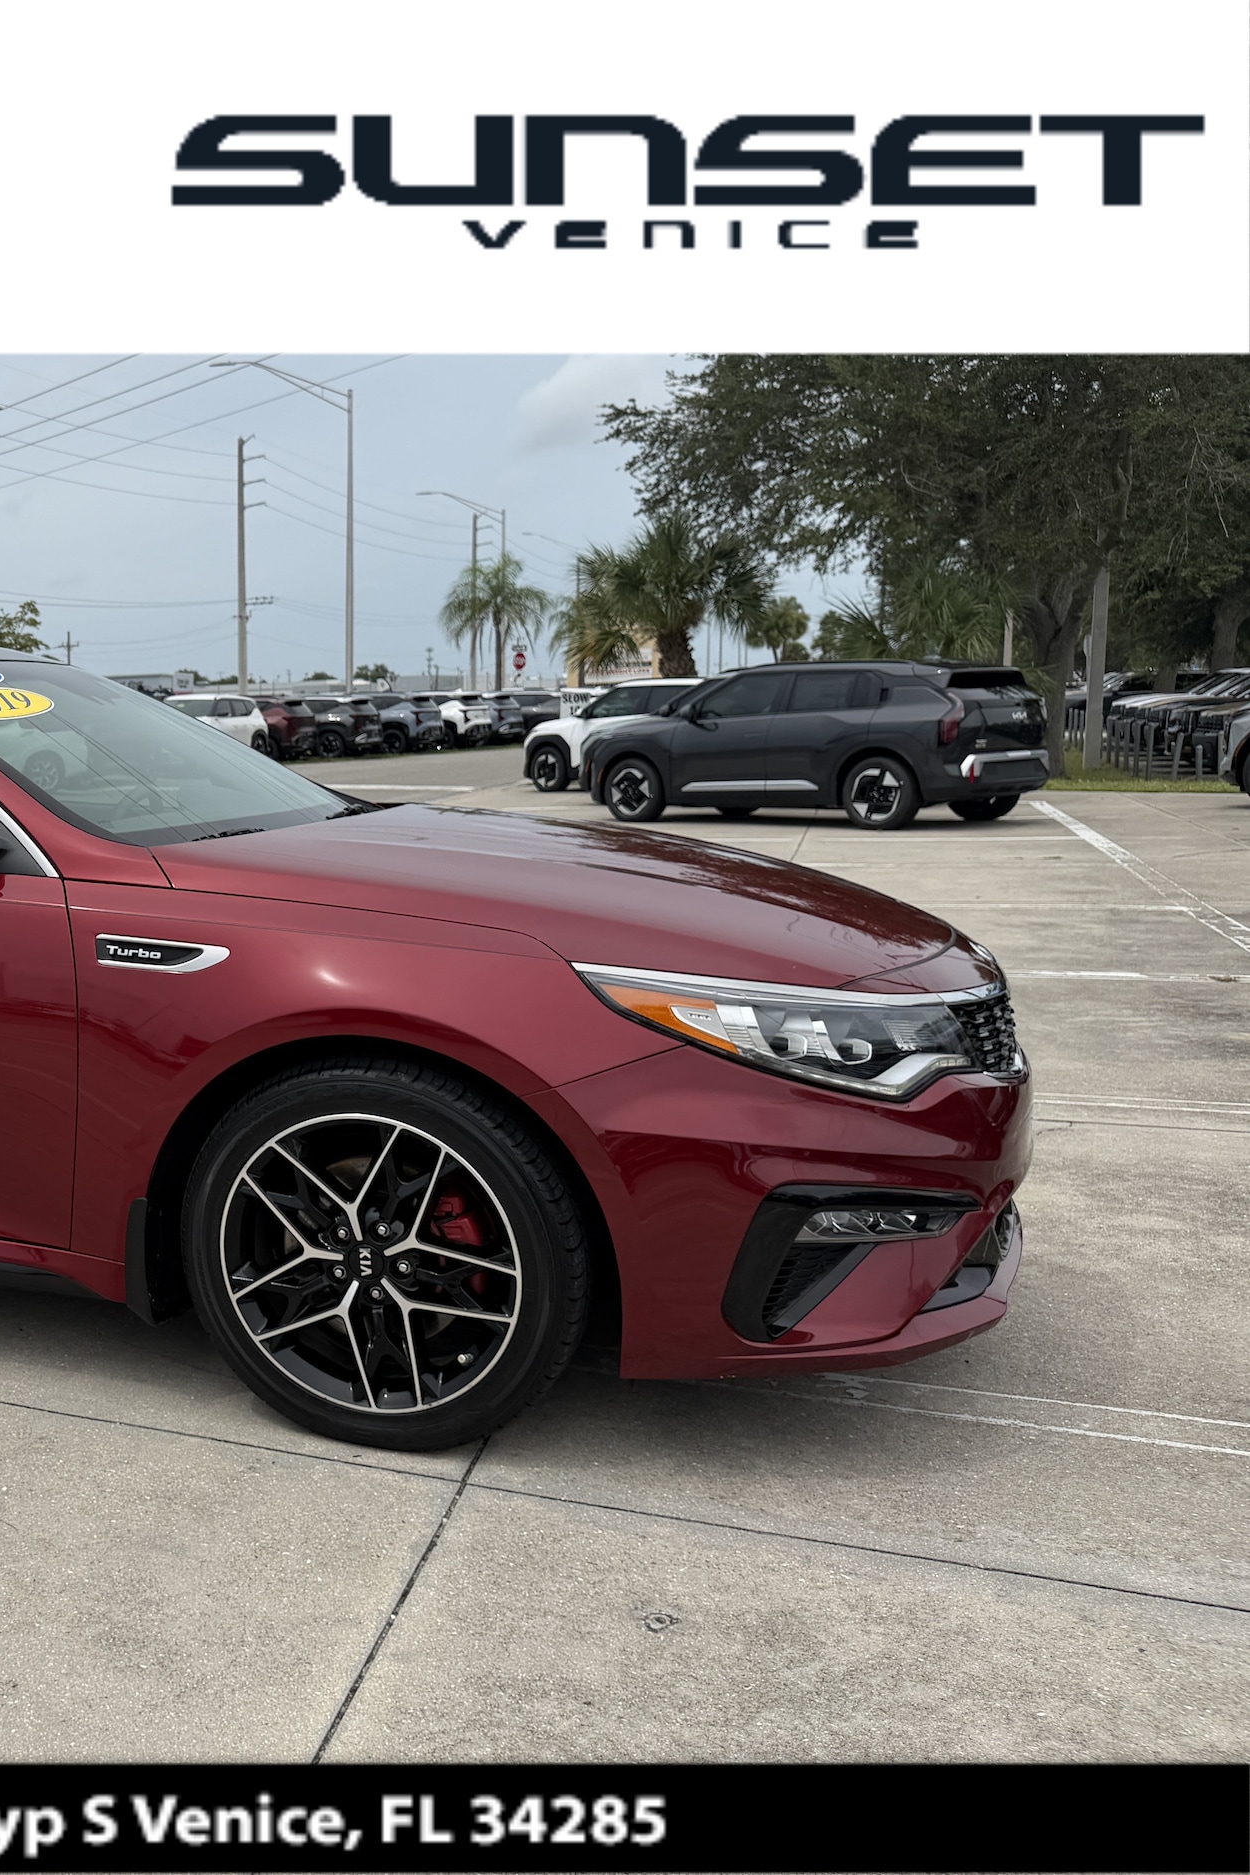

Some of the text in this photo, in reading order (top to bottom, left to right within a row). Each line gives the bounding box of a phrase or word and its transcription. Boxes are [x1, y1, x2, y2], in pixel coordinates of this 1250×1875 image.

[562, 693, 589, 704] SLOW
[105, 944, 162, 960] Turbo
[358, 1247, 373, 1277] KIA
